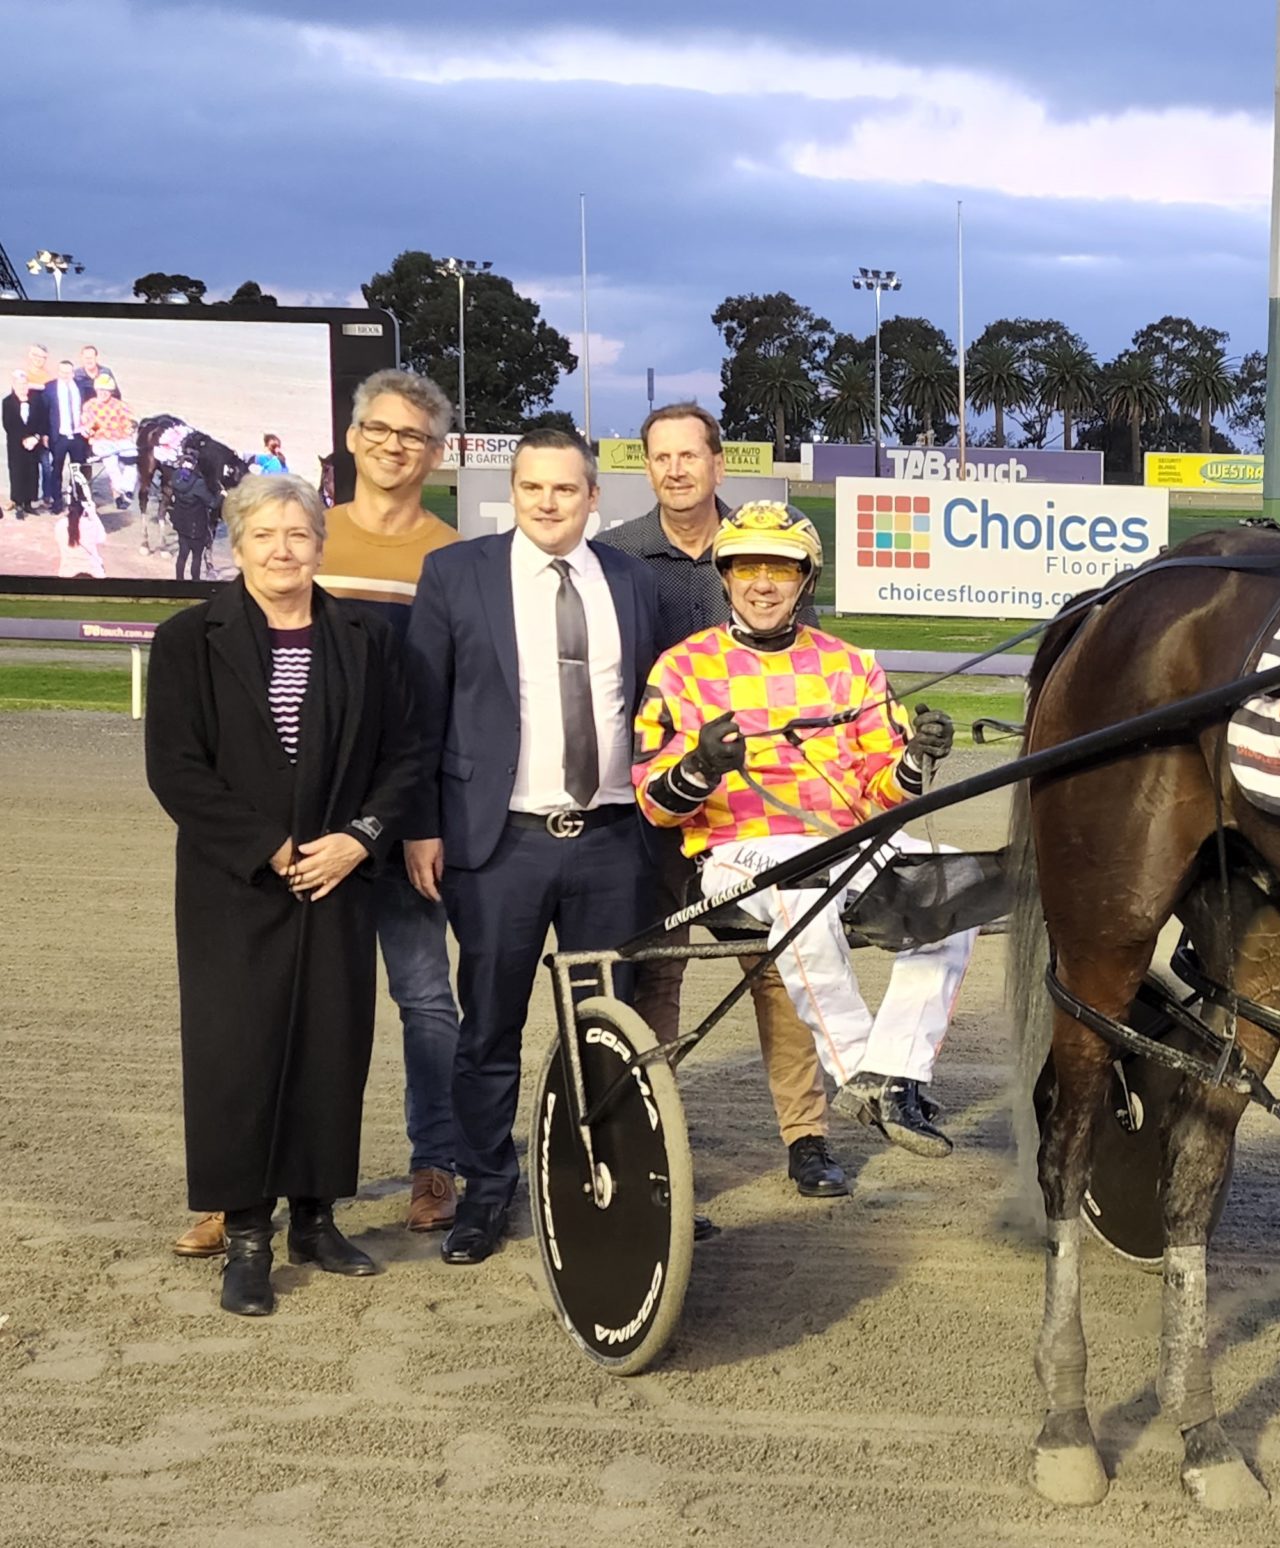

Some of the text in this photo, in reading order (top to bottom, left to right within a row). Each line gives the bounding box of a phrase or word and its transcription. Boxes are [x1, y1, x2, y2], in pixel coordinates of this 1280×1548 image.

[742, 447, 760, 455] AUTO
[886, 450, 1028, 483] TABtouch
[943, 497, 1150, 553] Choices
[585, 1027, 659, 1131] CORMA
[594, 1261, 663, 1346] CORIMA
